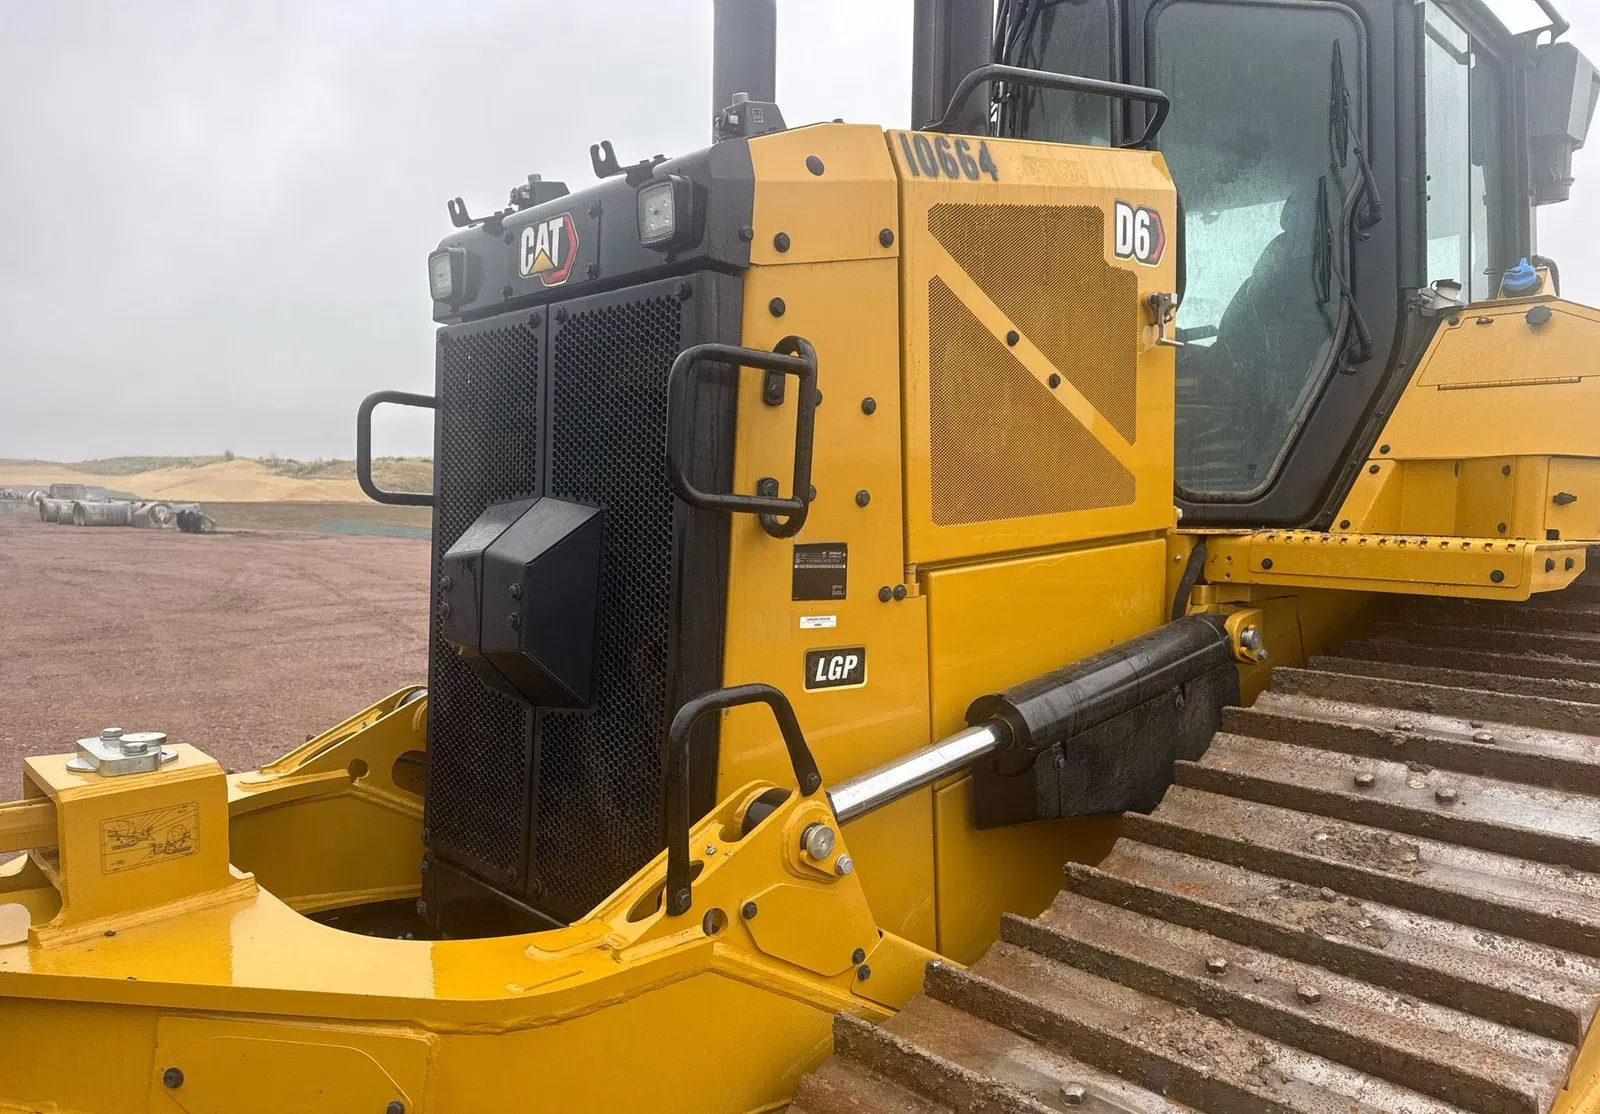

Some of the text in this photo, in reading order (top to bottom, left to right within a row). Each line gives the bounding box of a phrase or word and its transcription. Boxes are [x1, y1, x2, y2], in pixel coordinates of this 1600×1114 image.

[900, 132, 998, 182] 10664
[520, 217, 564, 275] CAT
[1116, 203, 1150, 259] D6
[815, 654, 858, 682] LGP
